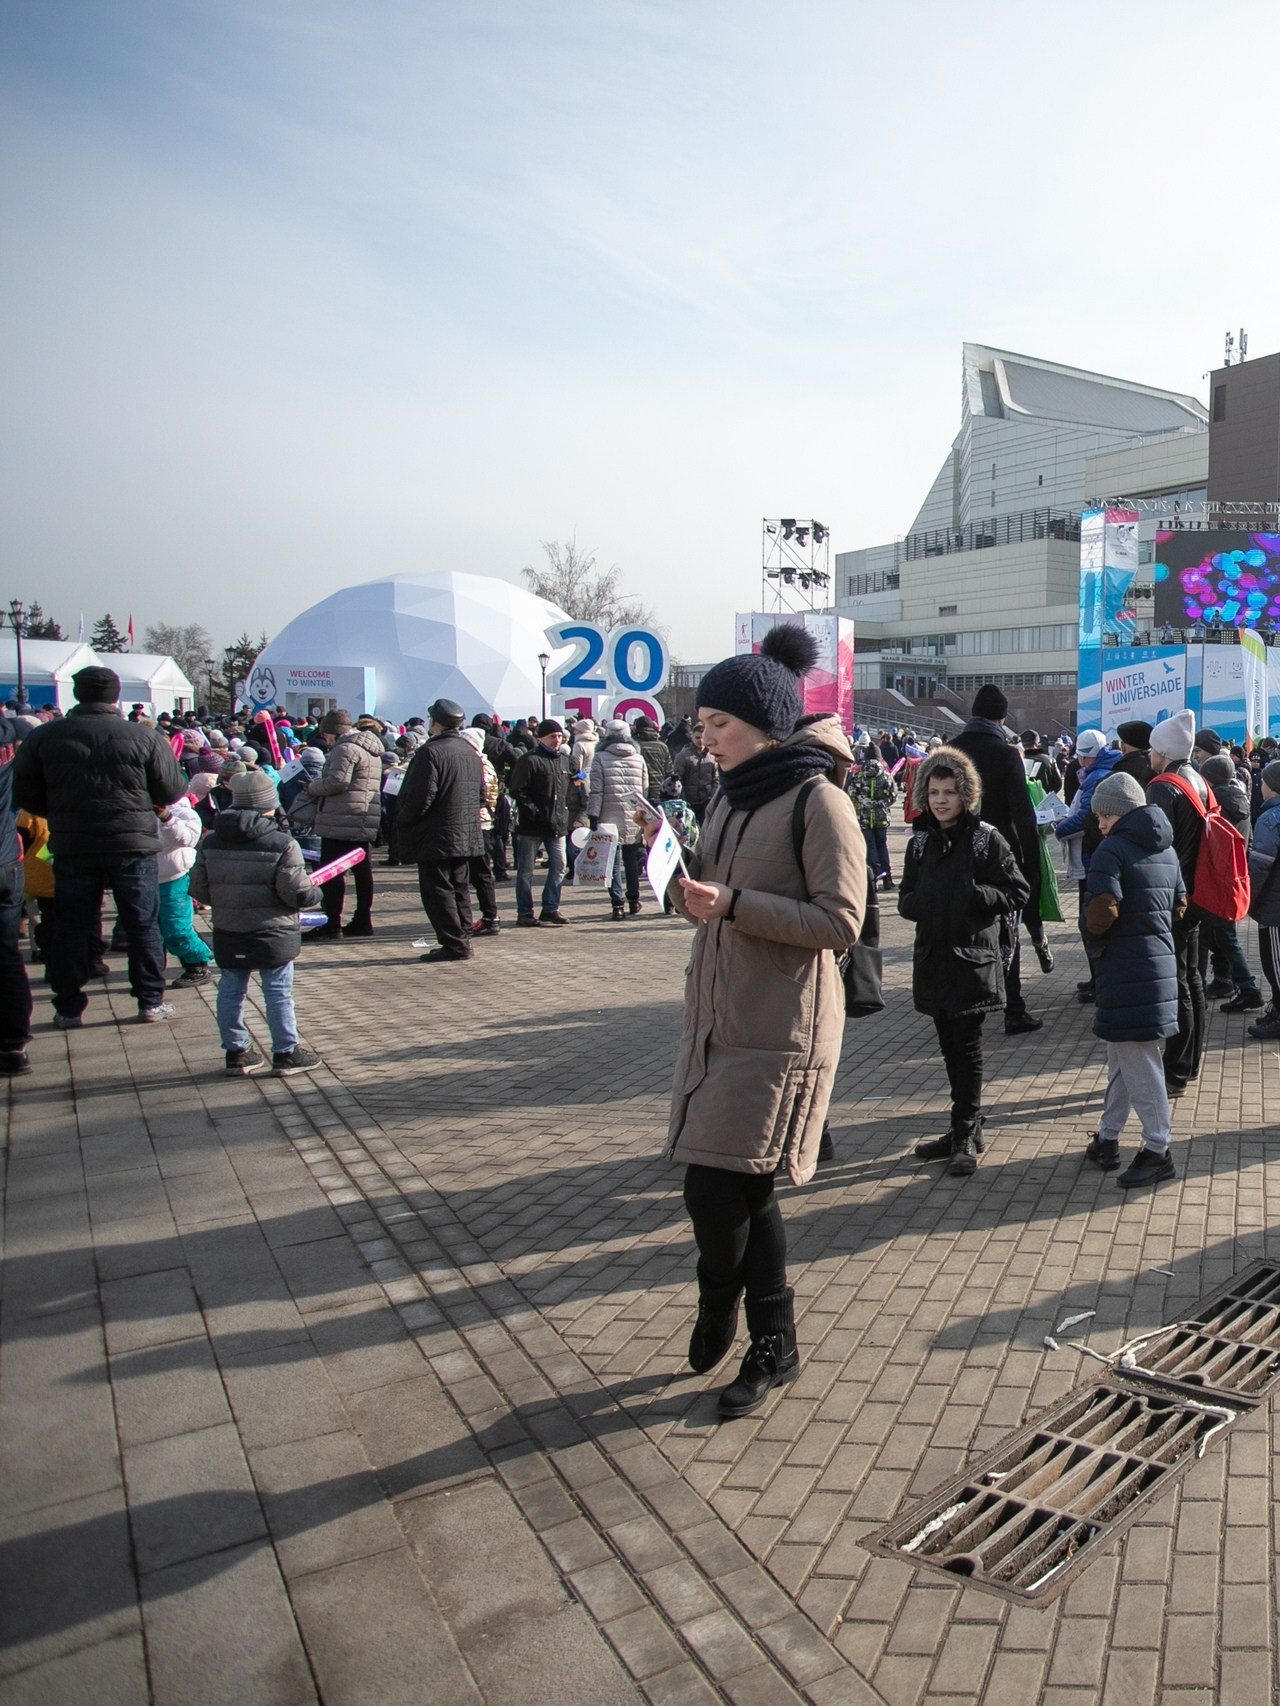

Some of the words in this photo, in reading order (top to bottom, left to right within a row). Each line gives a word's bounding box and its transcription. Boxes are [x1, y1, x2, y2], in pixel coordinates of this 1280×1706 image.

[556, 624, 667, 692] 20
[287, 679, 298, 687] TO
[300, 680, 335, 688] WINTER!
[289, 670, 331, 678] WELCOME
[1105, 672, 1146, 693] WINTER
[1112, 677, 1183, 706] UNIVERSIADE
